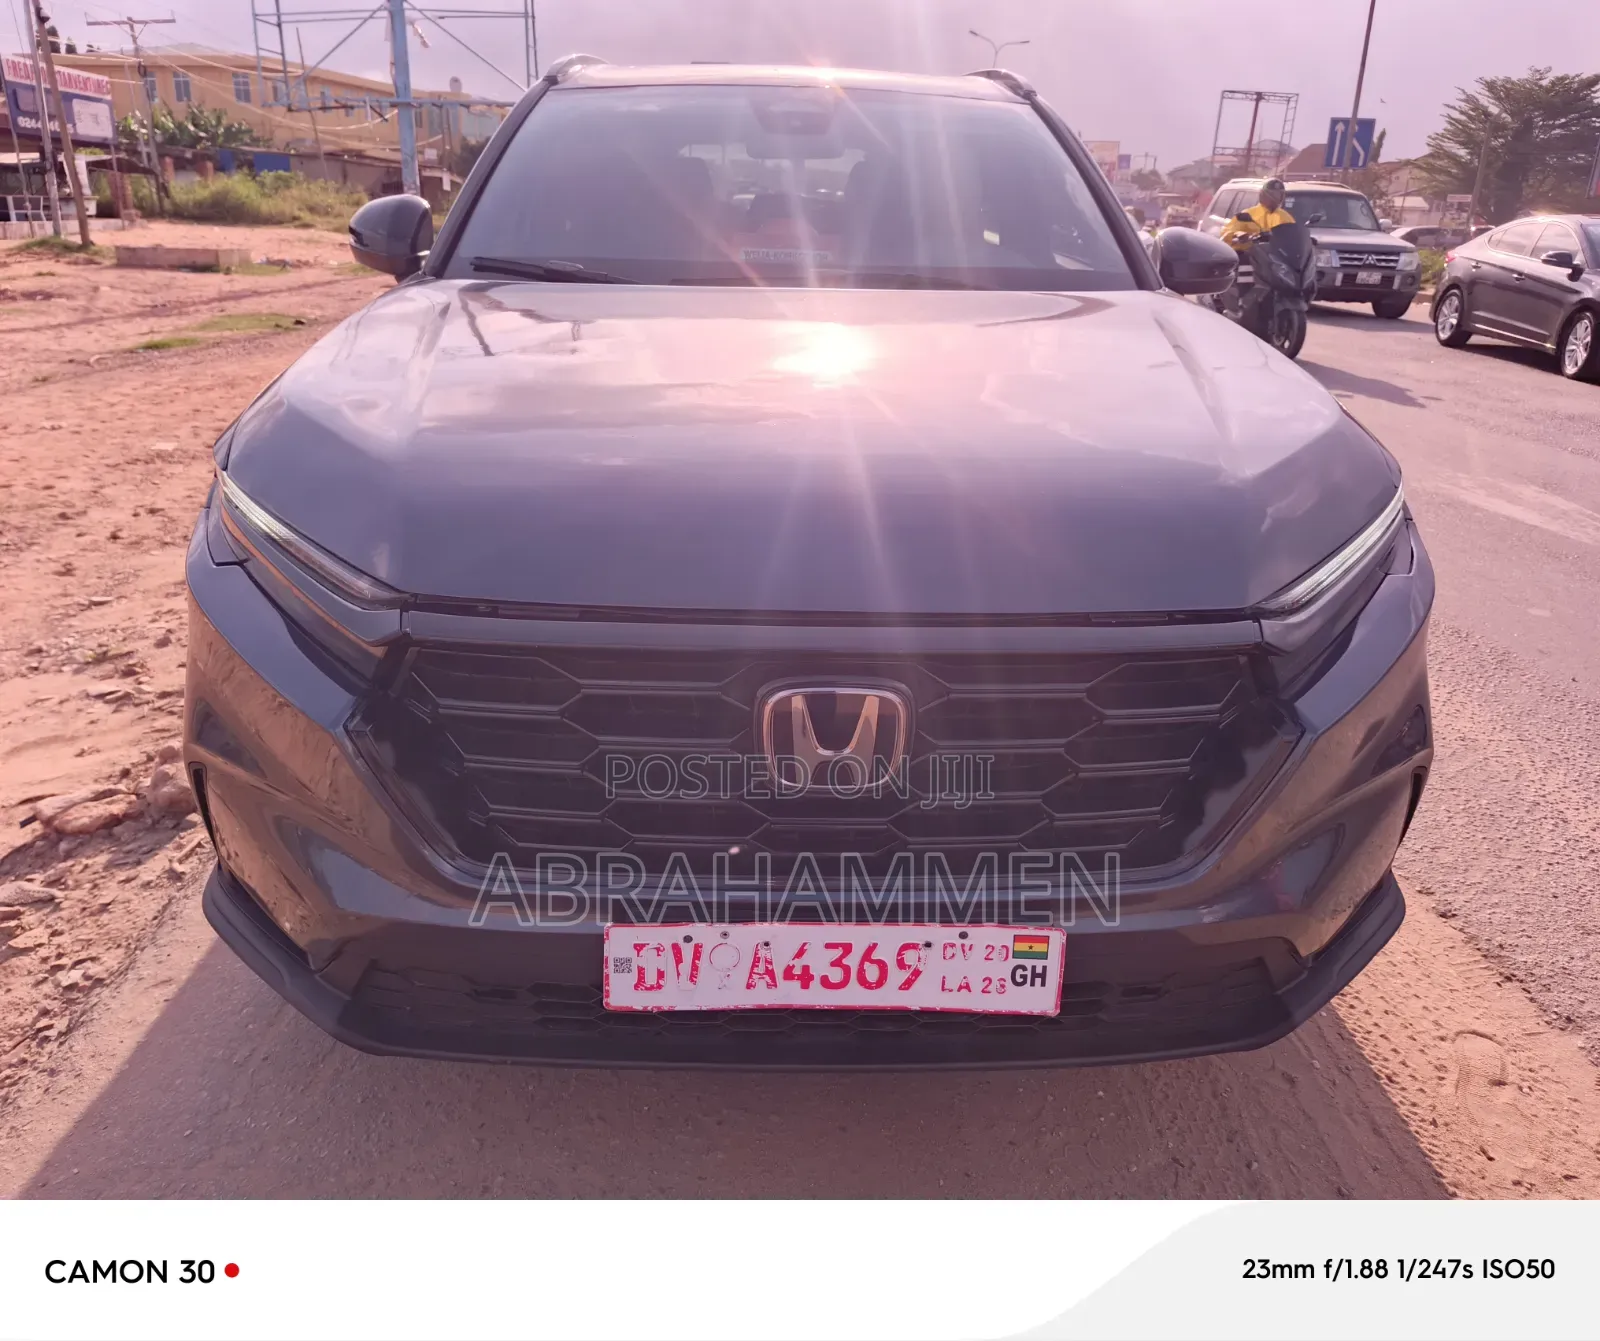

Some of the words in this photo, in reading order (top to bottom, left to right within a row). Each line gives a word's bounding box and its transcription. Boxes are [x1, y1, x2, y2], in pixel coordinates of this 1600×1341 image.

[745, 941, 927, 991] A4369
[1010, 964, 1048, 987] GH
[941, 975, 972, 993] LA
